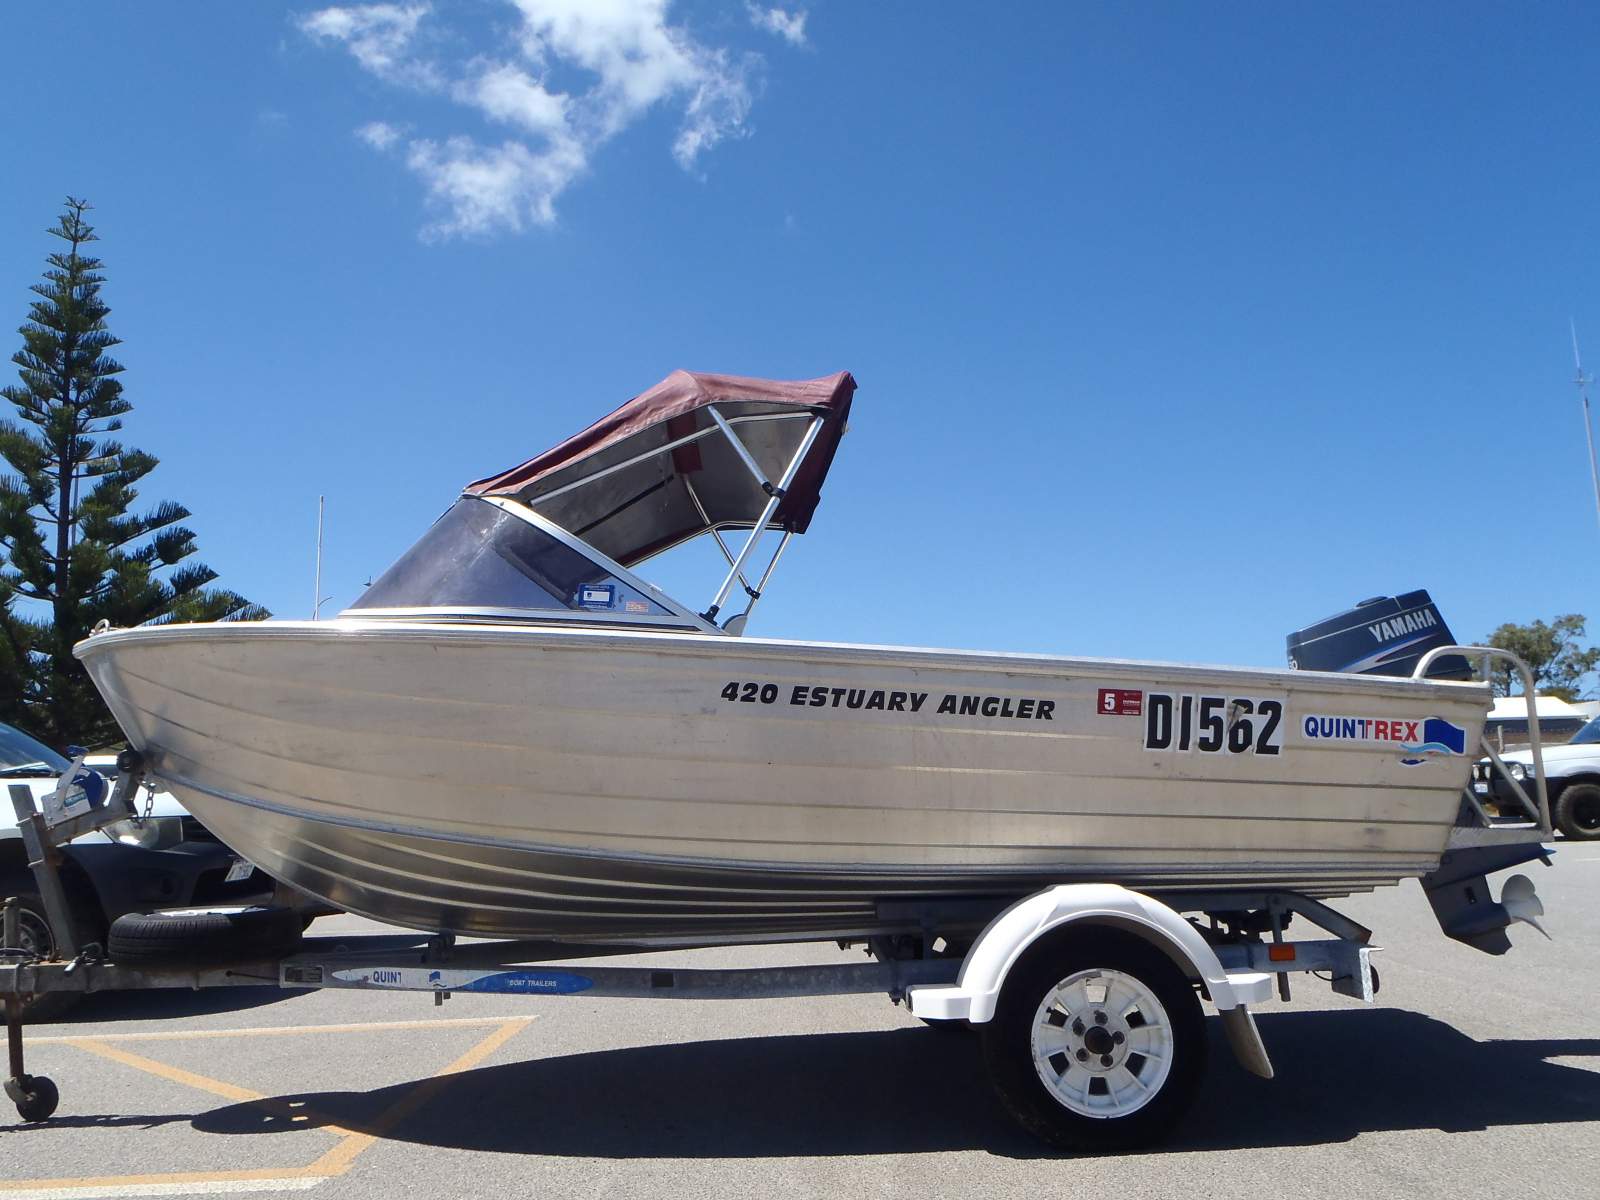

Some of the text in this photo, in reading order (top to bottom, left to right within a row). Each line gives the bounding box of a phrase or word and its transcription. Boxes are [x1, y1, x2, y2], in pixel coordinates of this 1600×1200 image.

[1368, 608, 1437, 643] YAMAHA
[720, 681, 1056, 721] 420 ESTUARY ANGLER
[1104, 692, 1116, 711] 5
[1304, 716, 1420, 743] QUINTREX
[509, 979, 557, 988] BOAT TRAILERS
